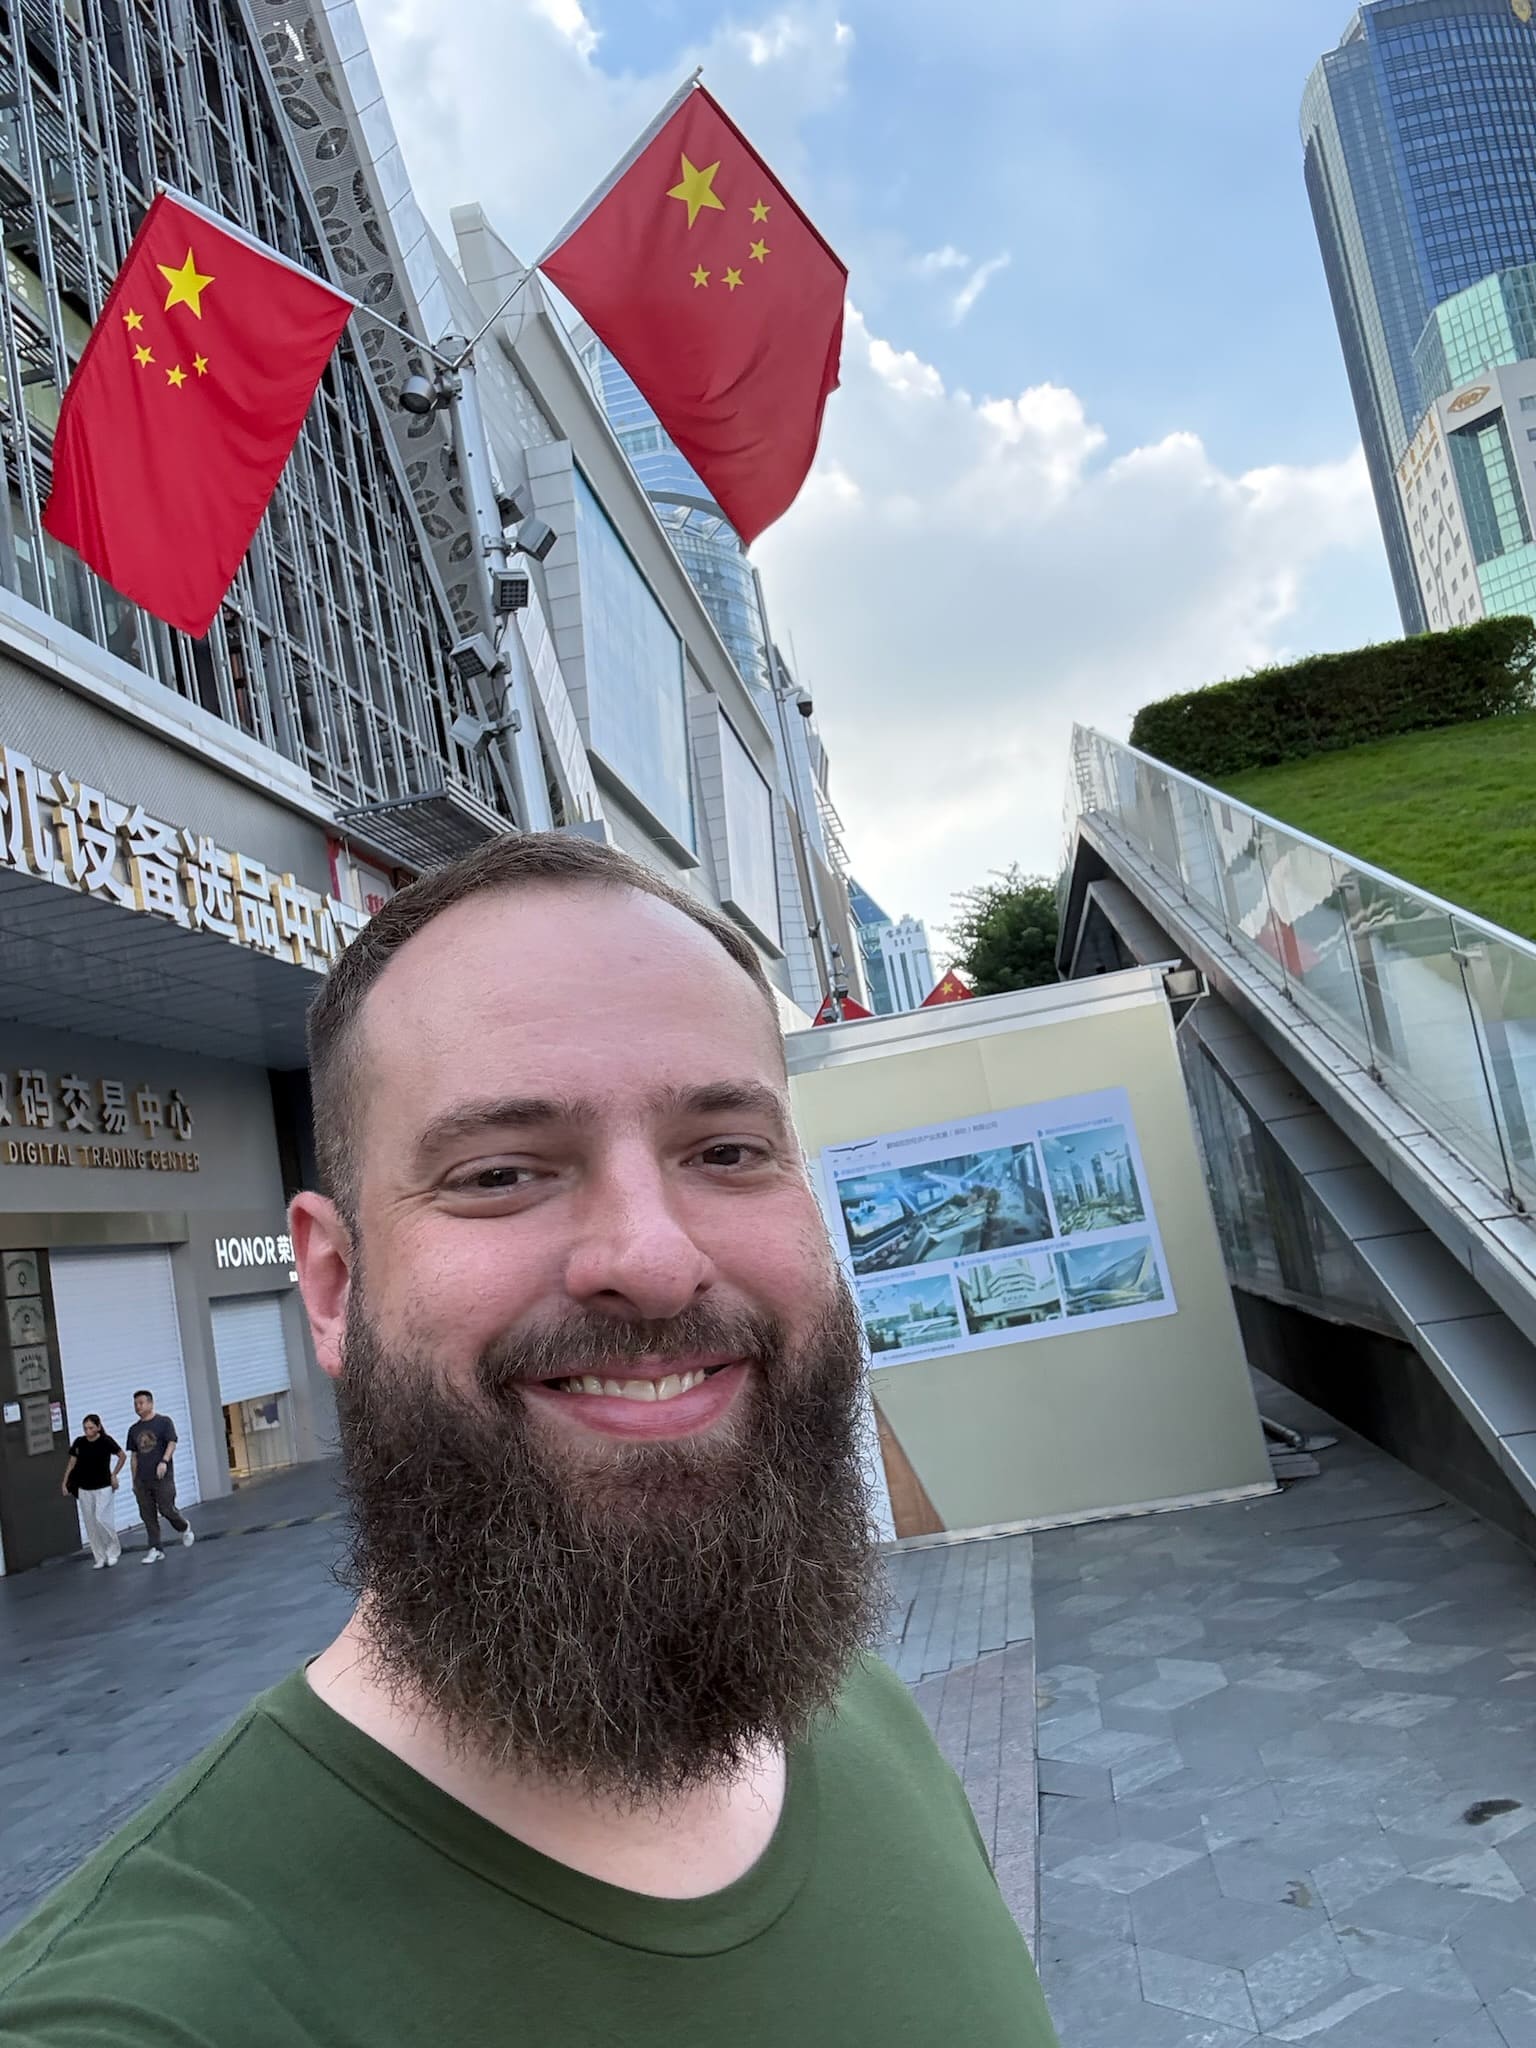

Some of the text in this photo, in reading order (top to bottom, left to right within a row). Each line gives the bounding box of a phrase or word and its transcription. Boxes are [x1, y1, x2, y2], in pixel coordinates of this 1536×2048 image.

[6, 1141, 201, 1172] DIGITAL TRADING CENTER
[215, 1235, 296, 1268] HONOR 荣
